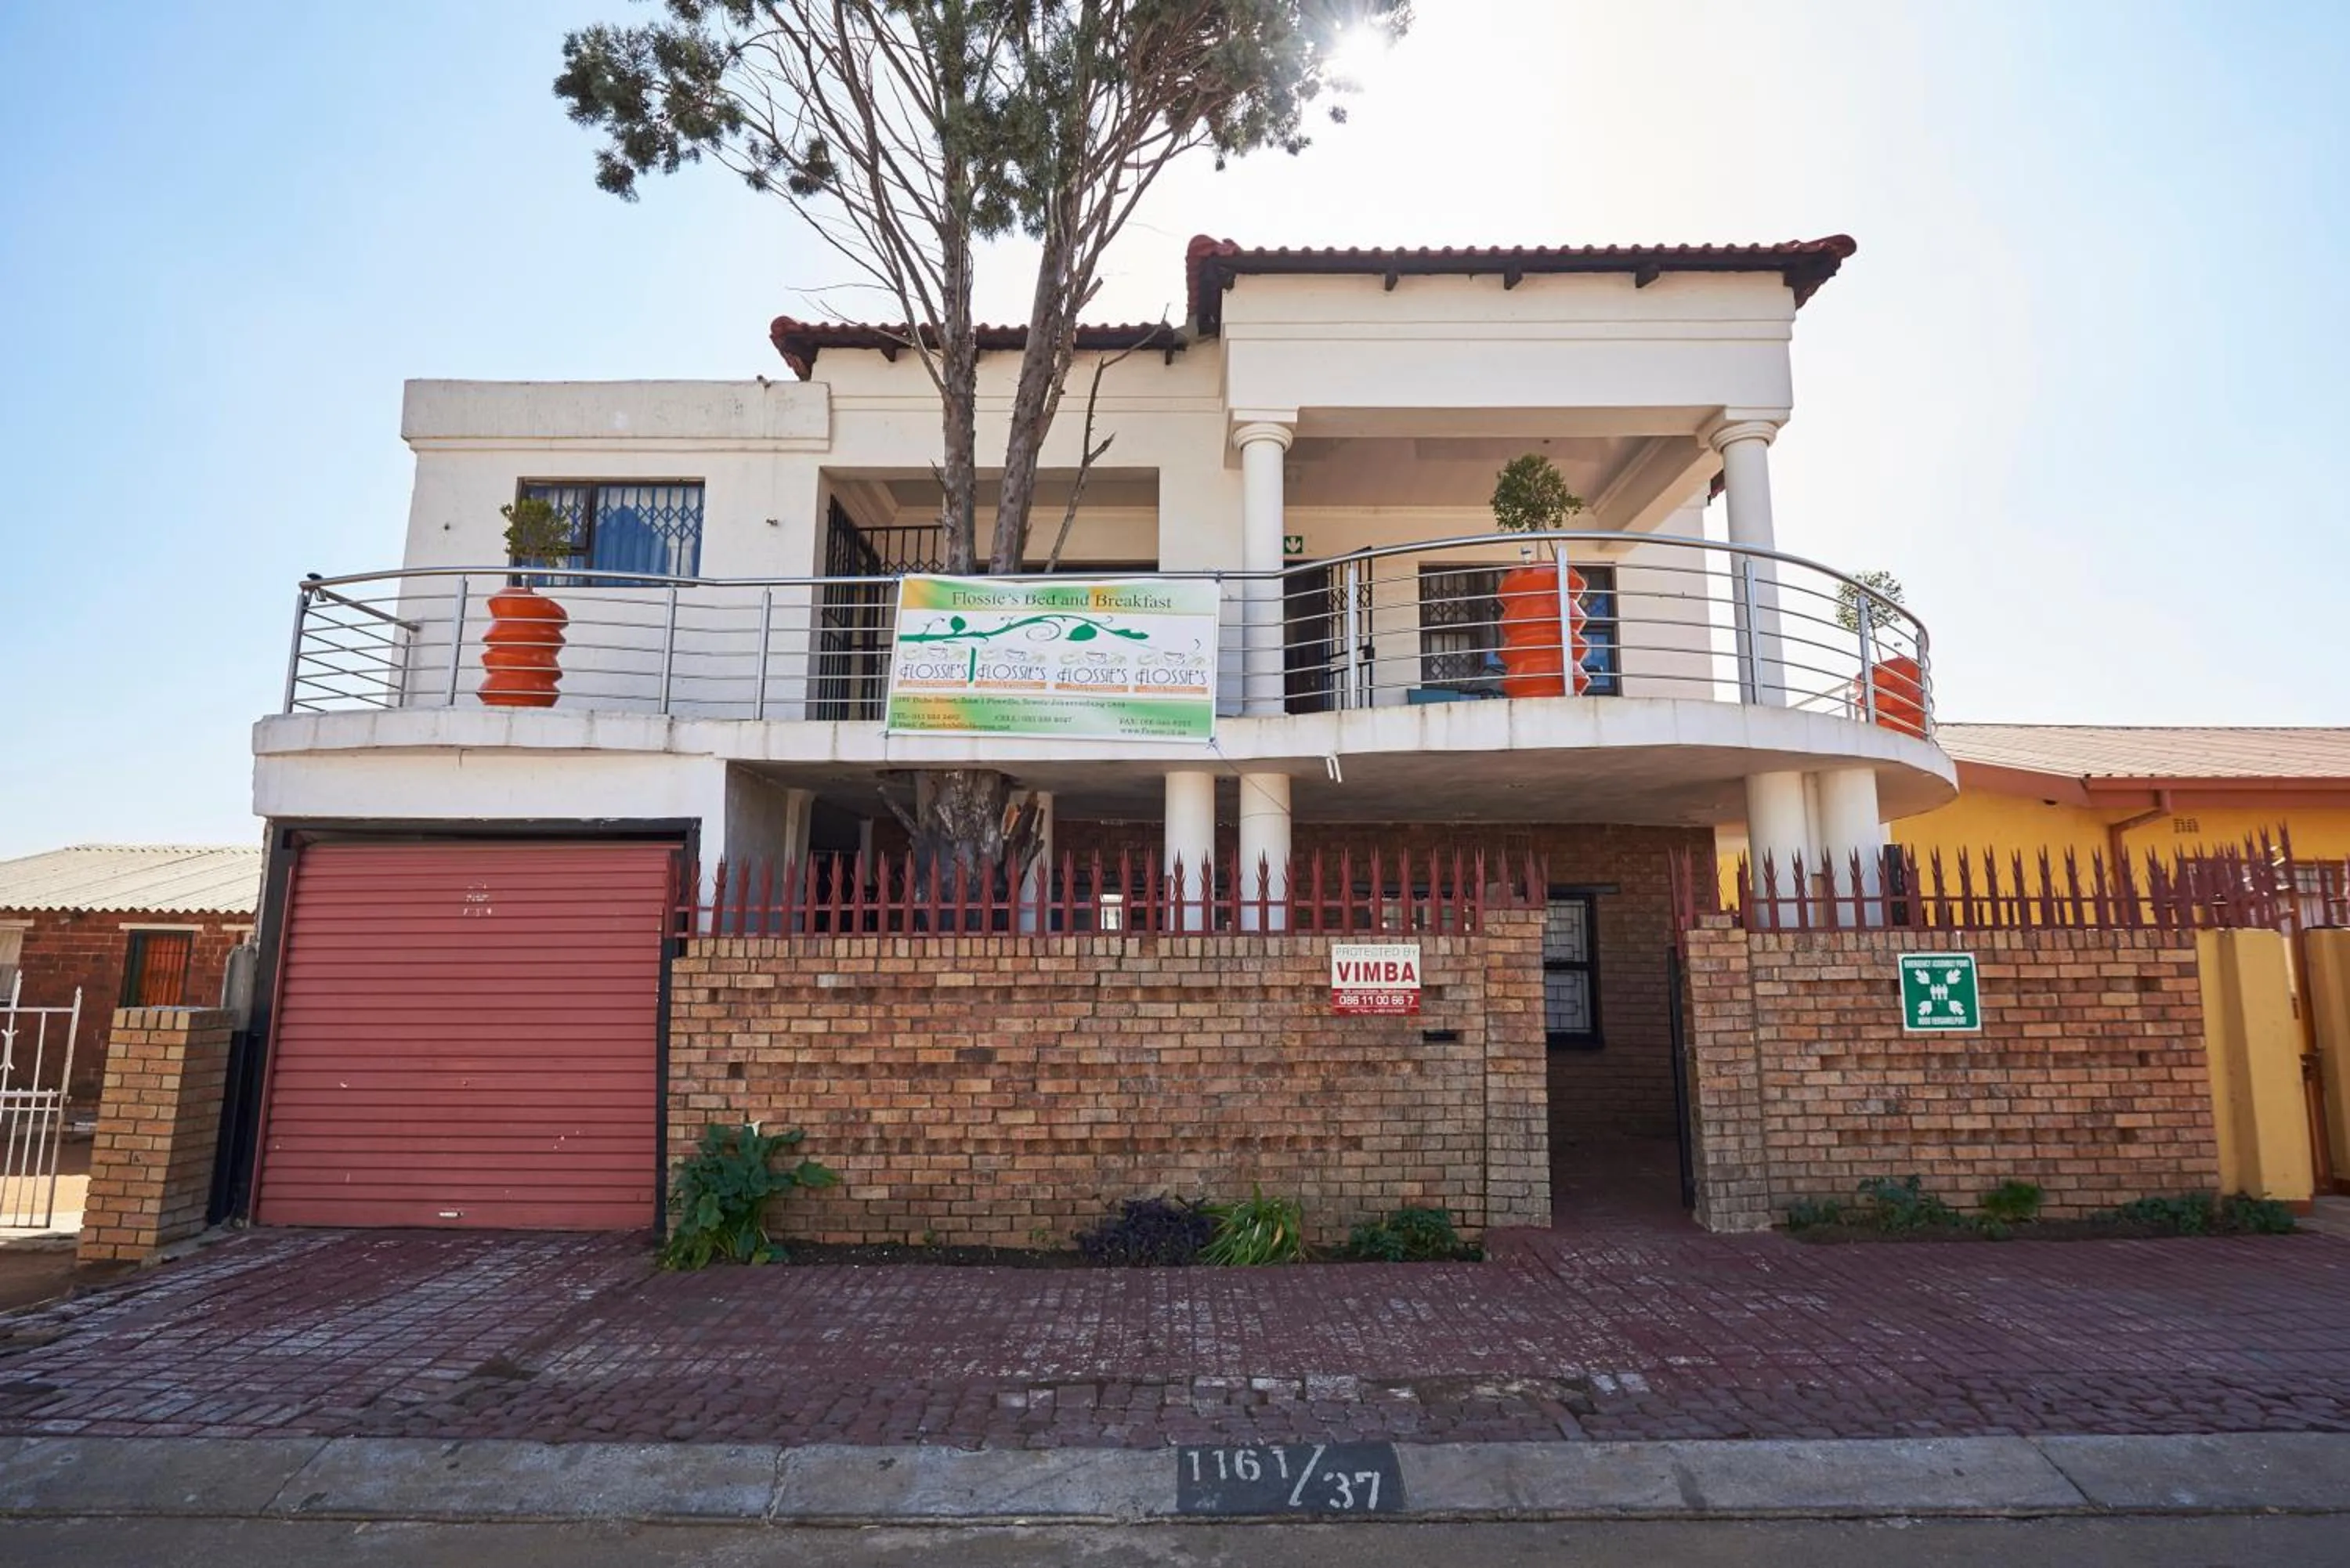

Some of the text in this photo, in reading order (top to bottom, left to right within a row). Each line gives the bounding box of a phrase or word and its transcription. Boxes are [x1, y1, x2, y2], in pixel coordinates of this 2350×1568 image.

[953, 591, 1172, 609] Flossie's Bed and Breakfast
[1403, 947, 1417, 956] BY
[1336, 962, 1415, 982] VIMBA
[1361, 995, 1373, 1006] 11
[1376, 995, 1390, 1006] 00
[1406, 995, 1414, 1006] 7
